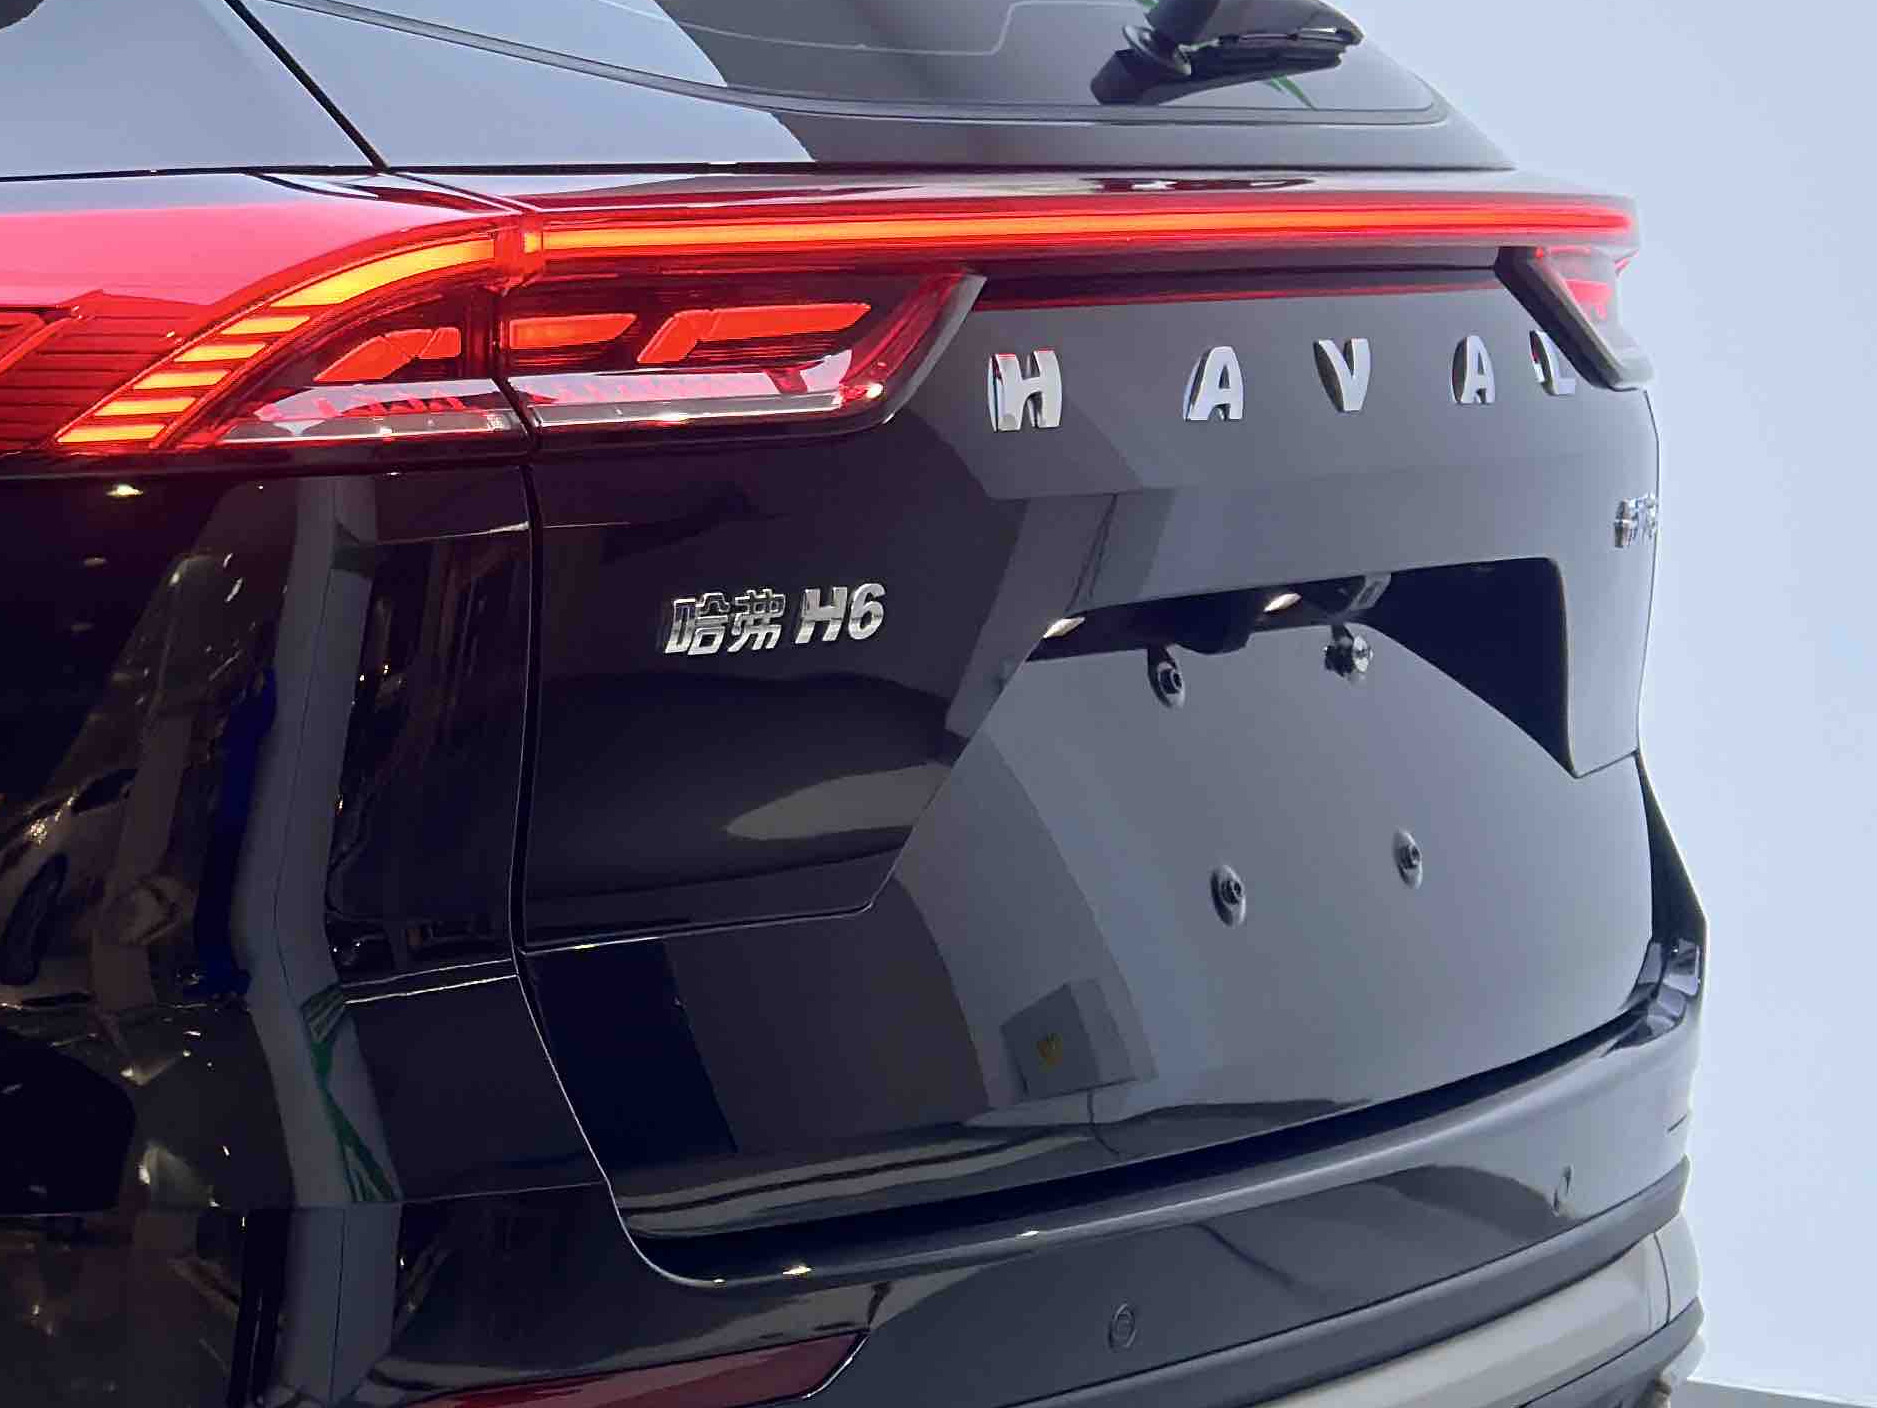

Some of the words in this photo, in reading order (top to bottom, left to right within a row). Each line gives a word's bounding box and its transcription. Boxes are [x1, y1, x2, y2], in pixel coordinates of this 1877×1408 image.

[988, 329, 1577, 433] HAVAL
[664, 588, 787, 656] 哈弗
[795, 583, 886, 645] H6
